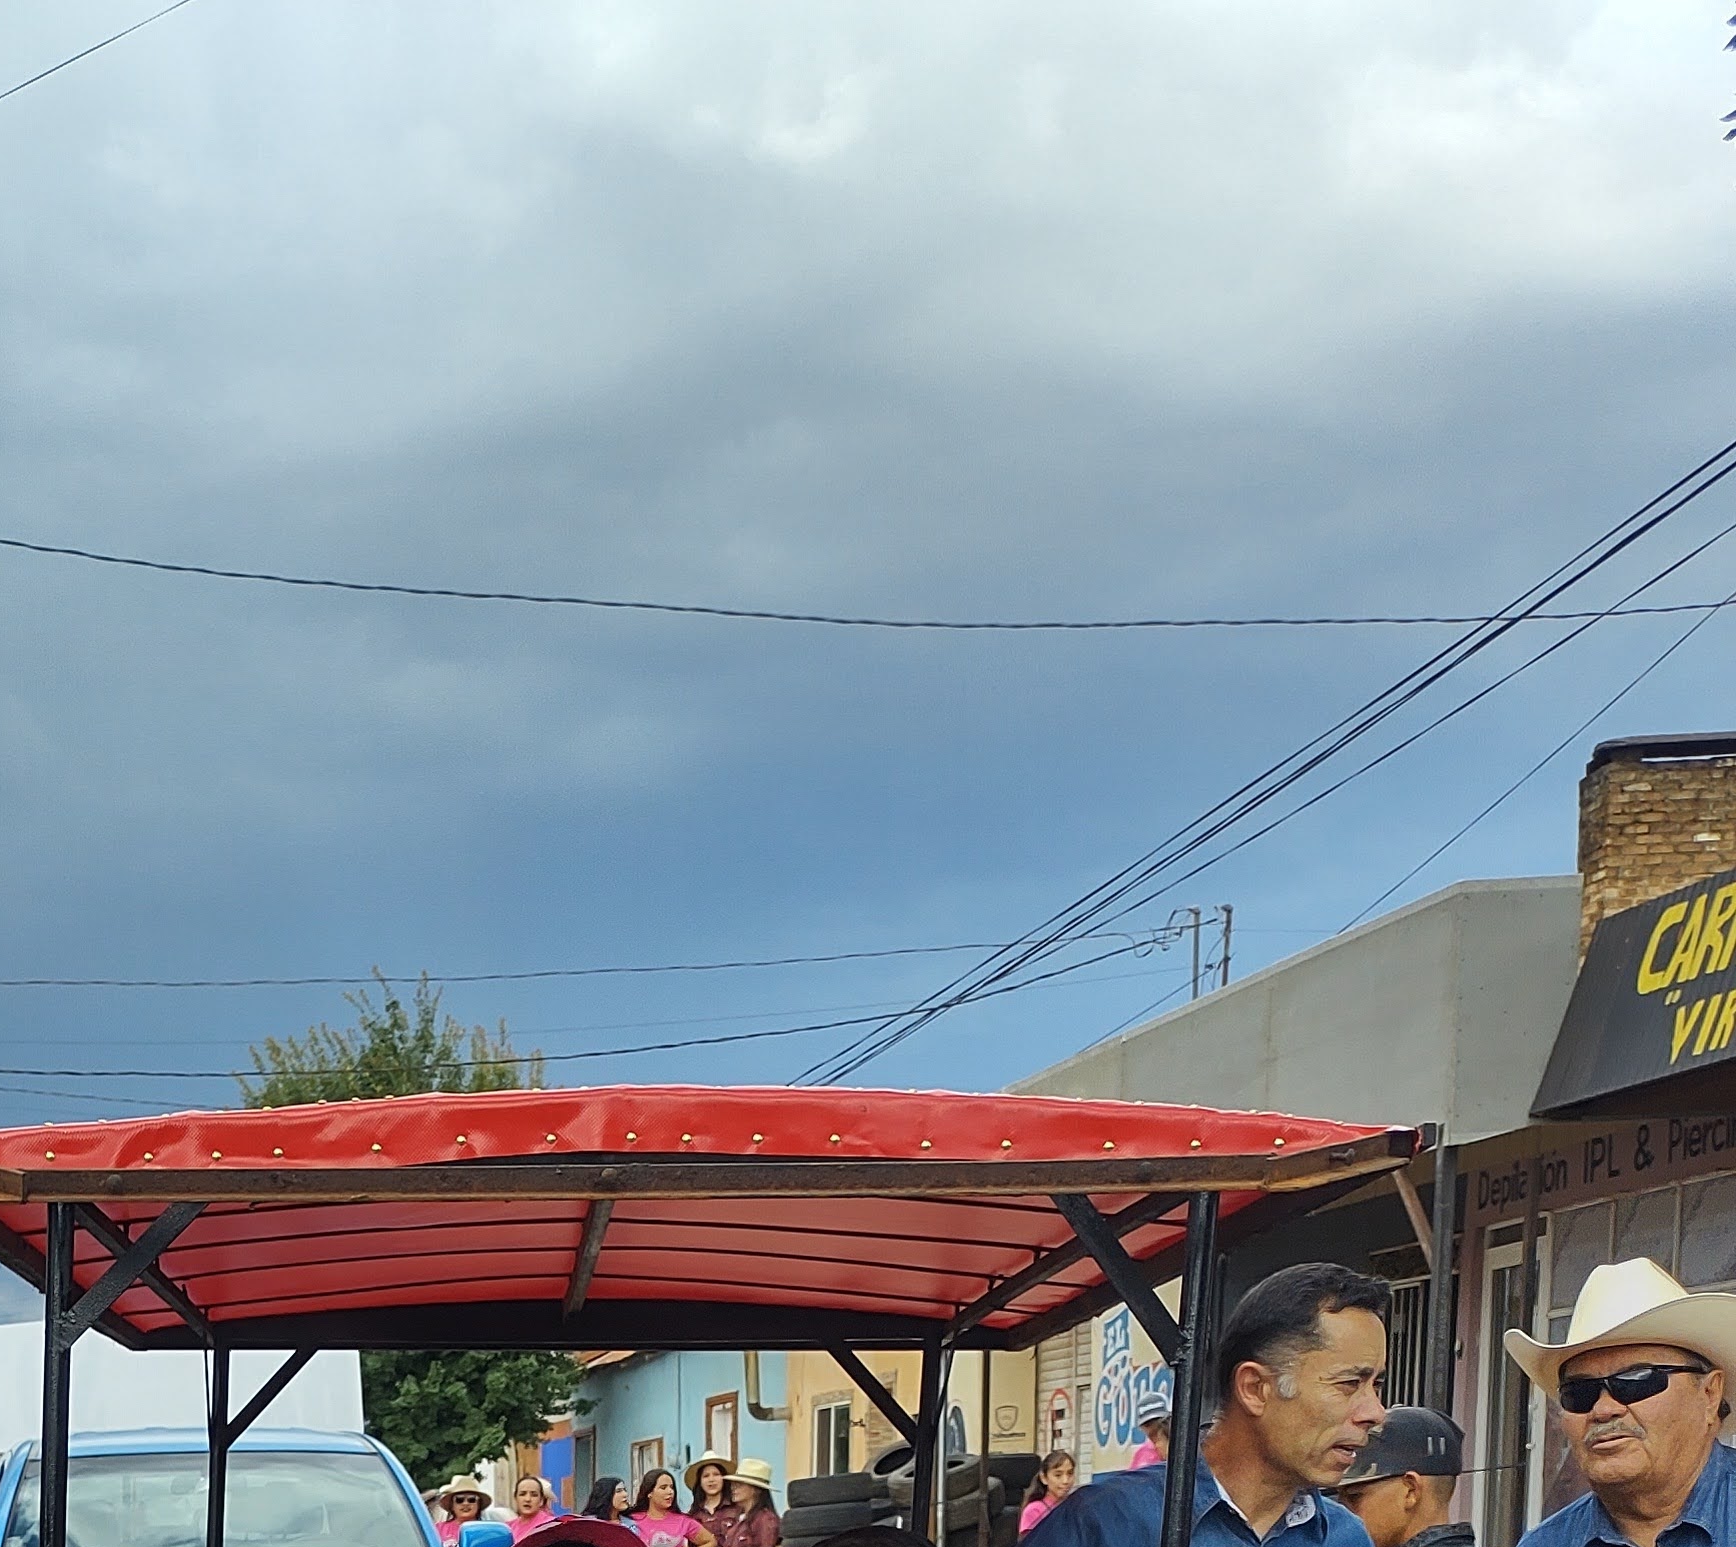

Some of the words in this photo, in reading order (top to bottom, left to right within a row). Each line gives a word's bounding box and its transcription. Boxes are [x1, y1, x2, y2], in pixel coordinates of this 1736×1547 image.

[1582, 1133, 1621, 1184] IPL
[1633, 1123, 1655, 1171] &
[1104, 1311, 1130, 1362] EL
